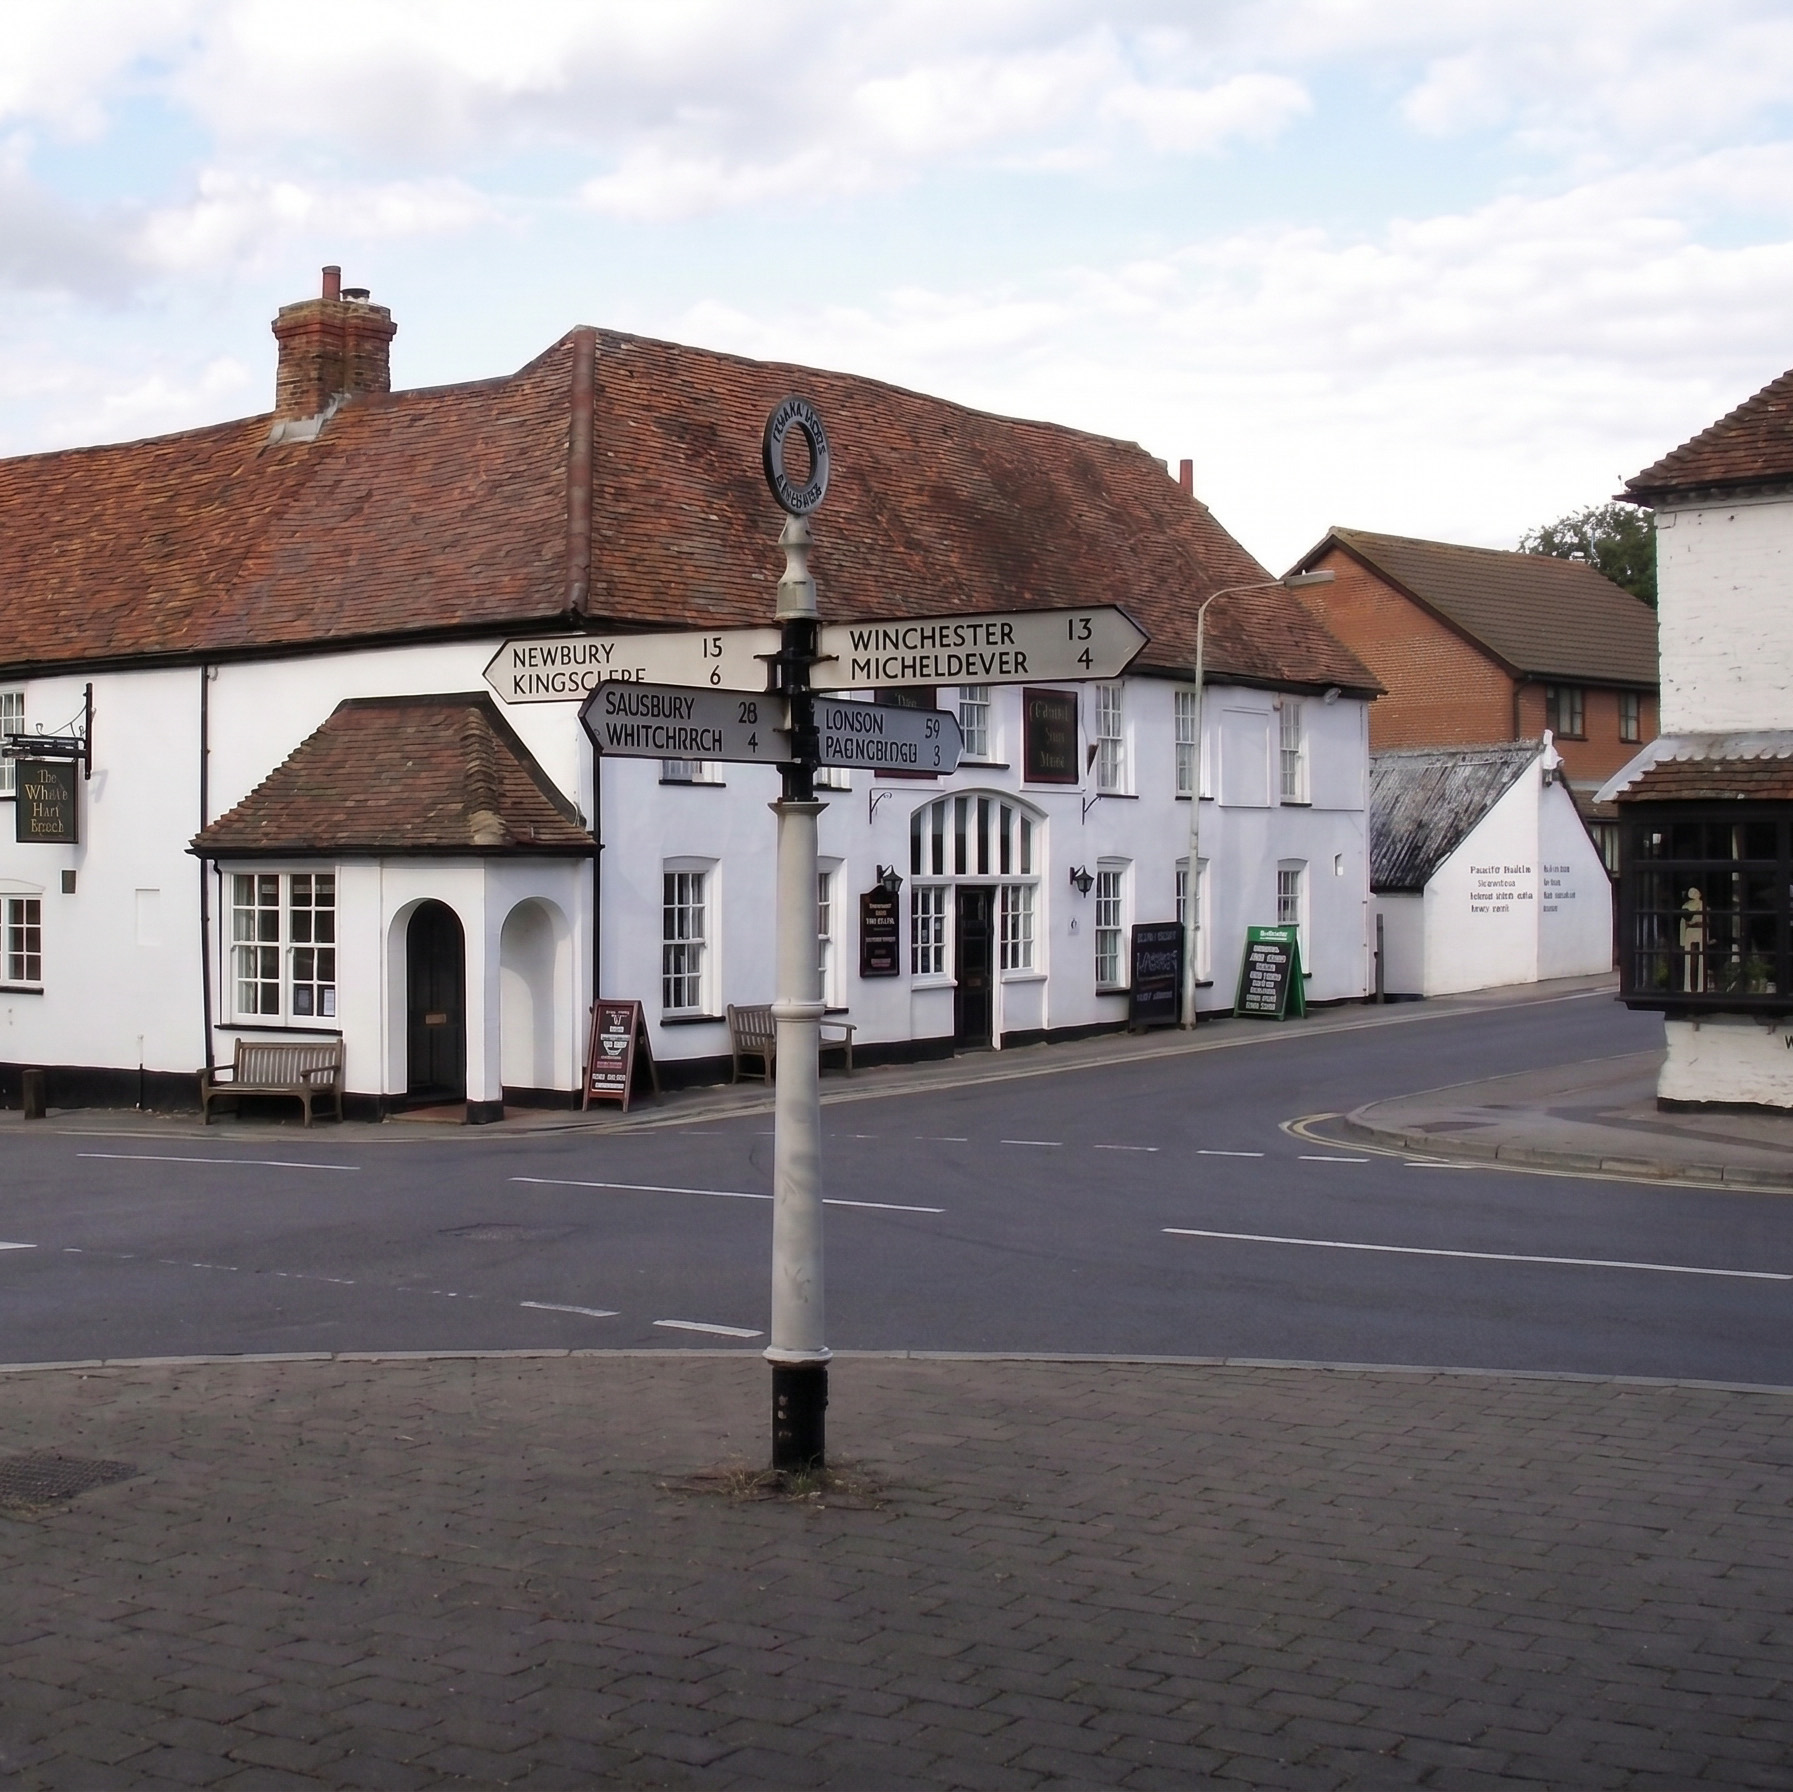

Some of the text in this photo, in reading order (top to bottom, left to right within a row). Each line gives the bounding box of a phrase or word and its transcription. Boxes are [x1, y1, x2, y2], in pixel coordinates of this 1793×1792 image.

[850, 617, 1093, 652] WINCHESTER 13
[513, 637, 723, 668] NEWBURY 15
[852, 647, 1094, 680] MICHELDEVER 4
[709, 665, 721, 685] 6
[826, 708, 940, 739] LONSON 59
[747, 732, 759, 753] 4
[933, 745, 940, 767] 3
